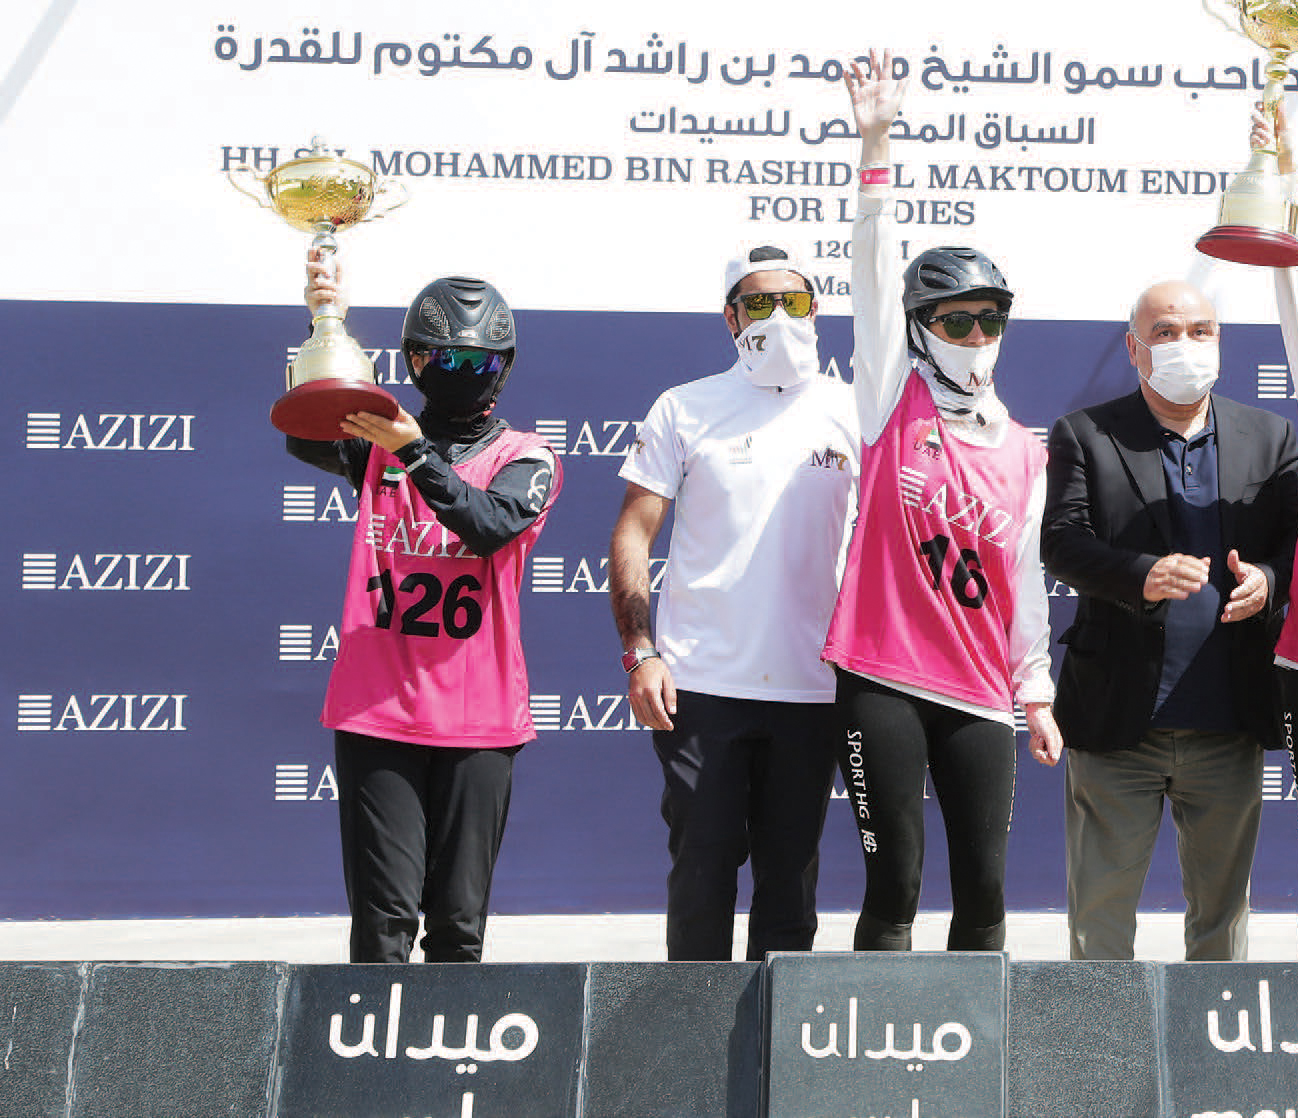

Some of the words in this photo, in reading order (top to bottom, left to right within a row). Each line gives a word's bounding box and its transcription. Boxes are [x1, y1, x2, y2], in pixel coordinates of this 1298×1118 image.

[214, 24, 363, 72] للقدرة
[373, 33, 533, 77] مكتوم
[545, 30, 596, 81] آل
[604, 32, 709, 84] راشد
[920, 44, 1051, 94] الشيخ
[720, 52, 776, 89] بن
[1064, 61, 1163, 95] سمو
[629, 106, 790, 144] للسيدات
[799, 110, 966, 145] المخص
[974, 112, 1095, 152] السباق
[370, 150, 613, 181] MOHAMMED
[625, 157, 694, 183] BIN
[706, 158, 853, 186] RASHID
[928, 164, 1128, 194] MAKTOUM
[749, 195, 825, 222] FOR
[837, 197, 976, 226] LDIES
[61, 413, 196, 451] AZIZI
[376, 486, 398, 498] AE
[921, 482, 1014, 549] AZIZ
[57, 553, 192, 591] AZIZI
[919, 533, 989, 610] 16
[366, 568, 483, 640] 126
[53, 694, 188, 731] AZIZI
[328, 982, 540, 1075] ميدان
[800, 996, 973, 1073] ميدان
